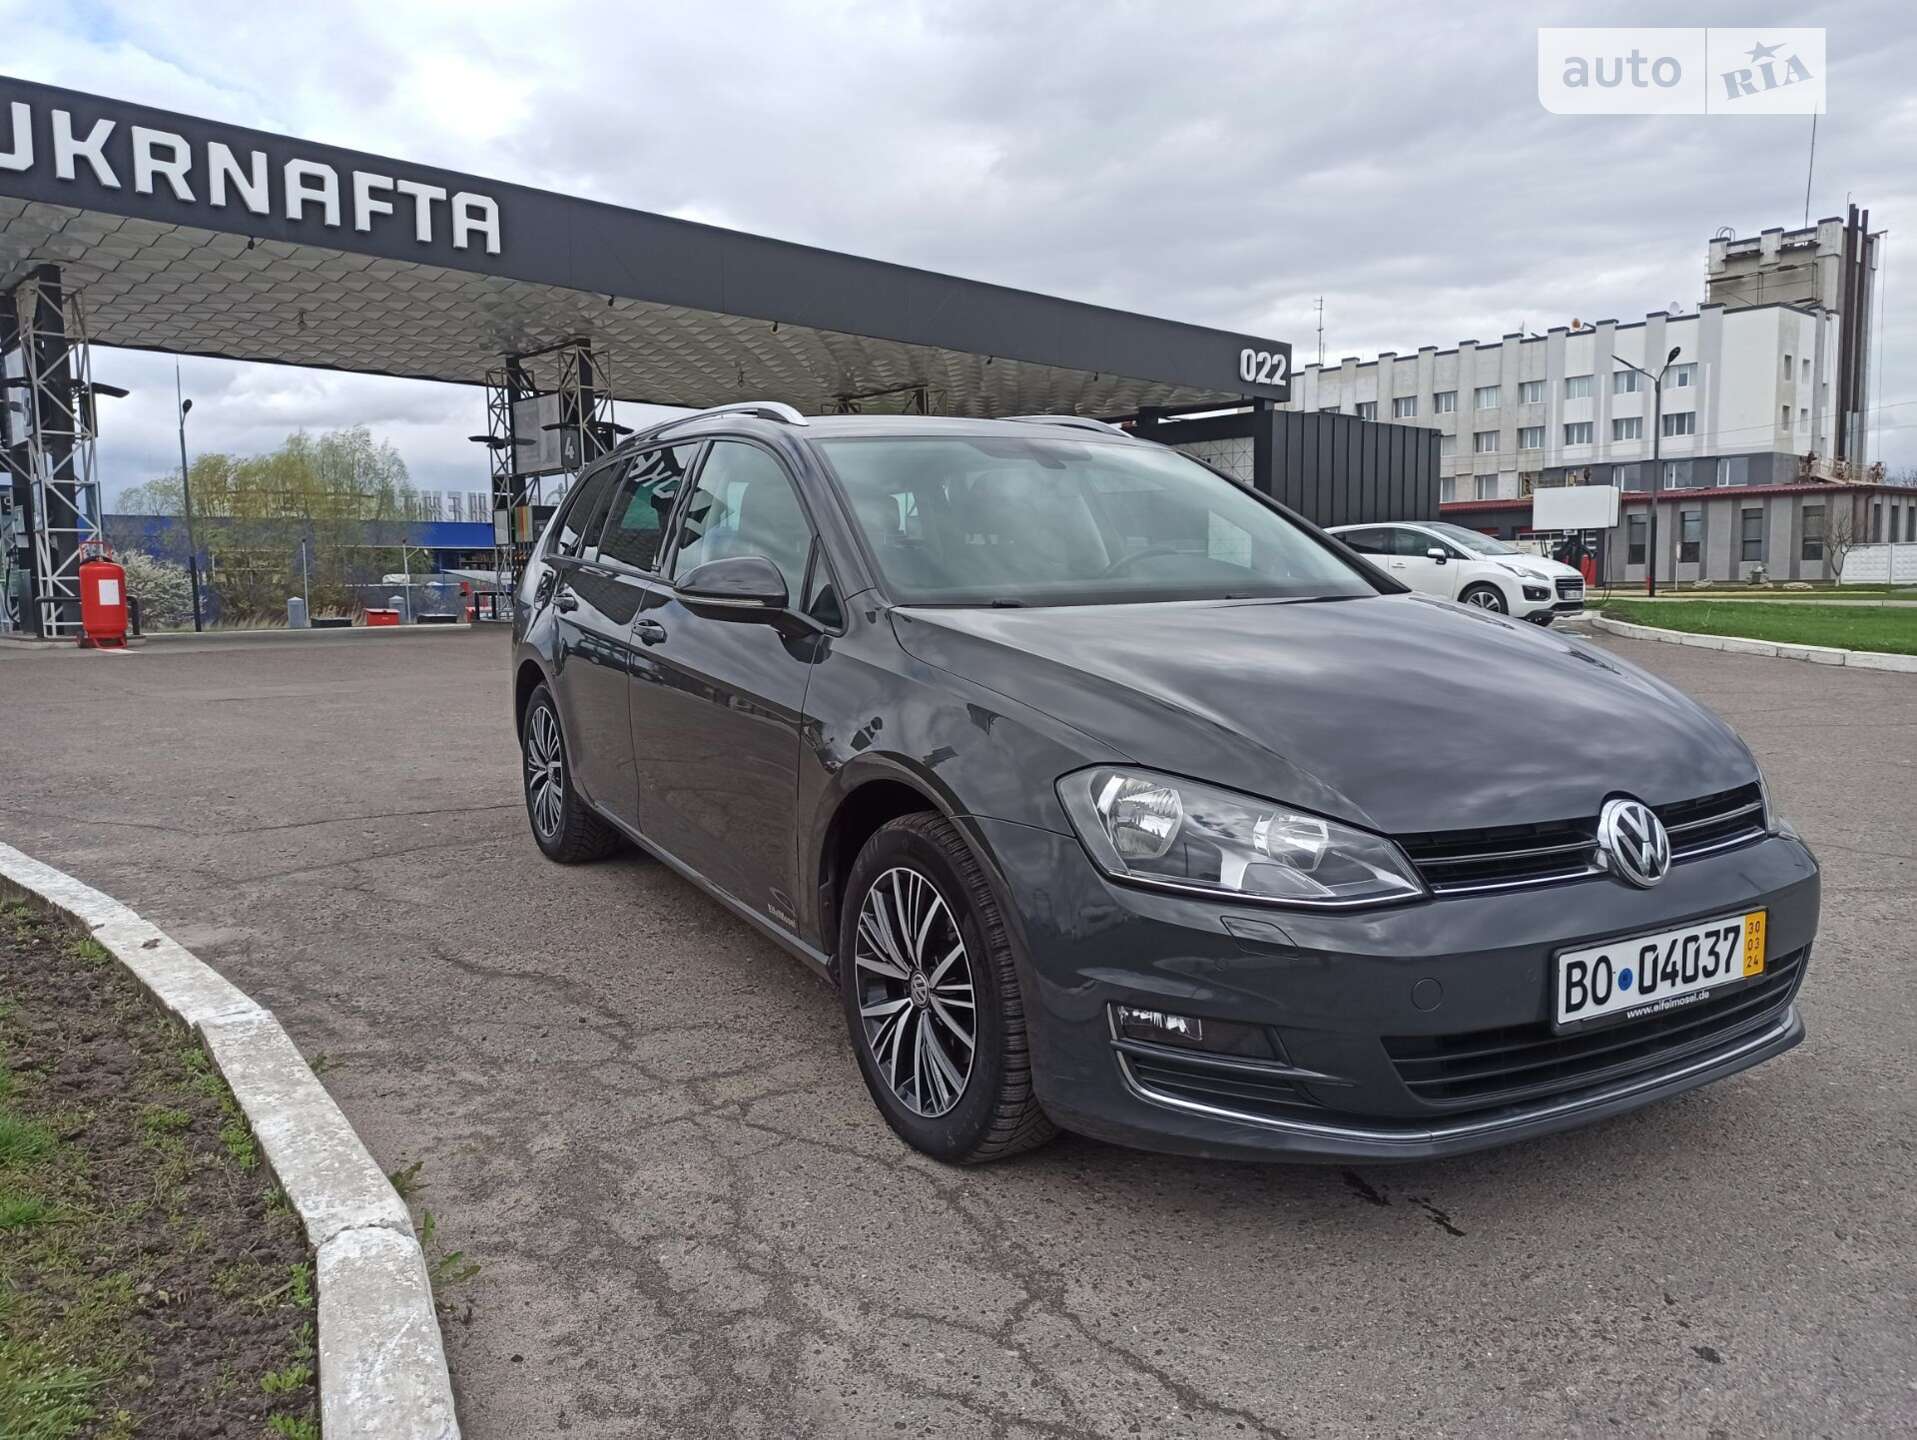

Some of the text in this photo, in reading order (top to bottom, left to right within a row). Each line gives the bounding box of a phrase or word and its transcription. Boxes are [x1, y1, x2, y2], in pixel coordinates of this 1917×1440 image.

[1240, 348, 1287, 386] 022
[564, 436, 575, 459] 4
[1748, 920, 1761, 935] 30
[1747, 937, 1760, 951] 03
[1565, 925, 1741, 1014] BO 04037
